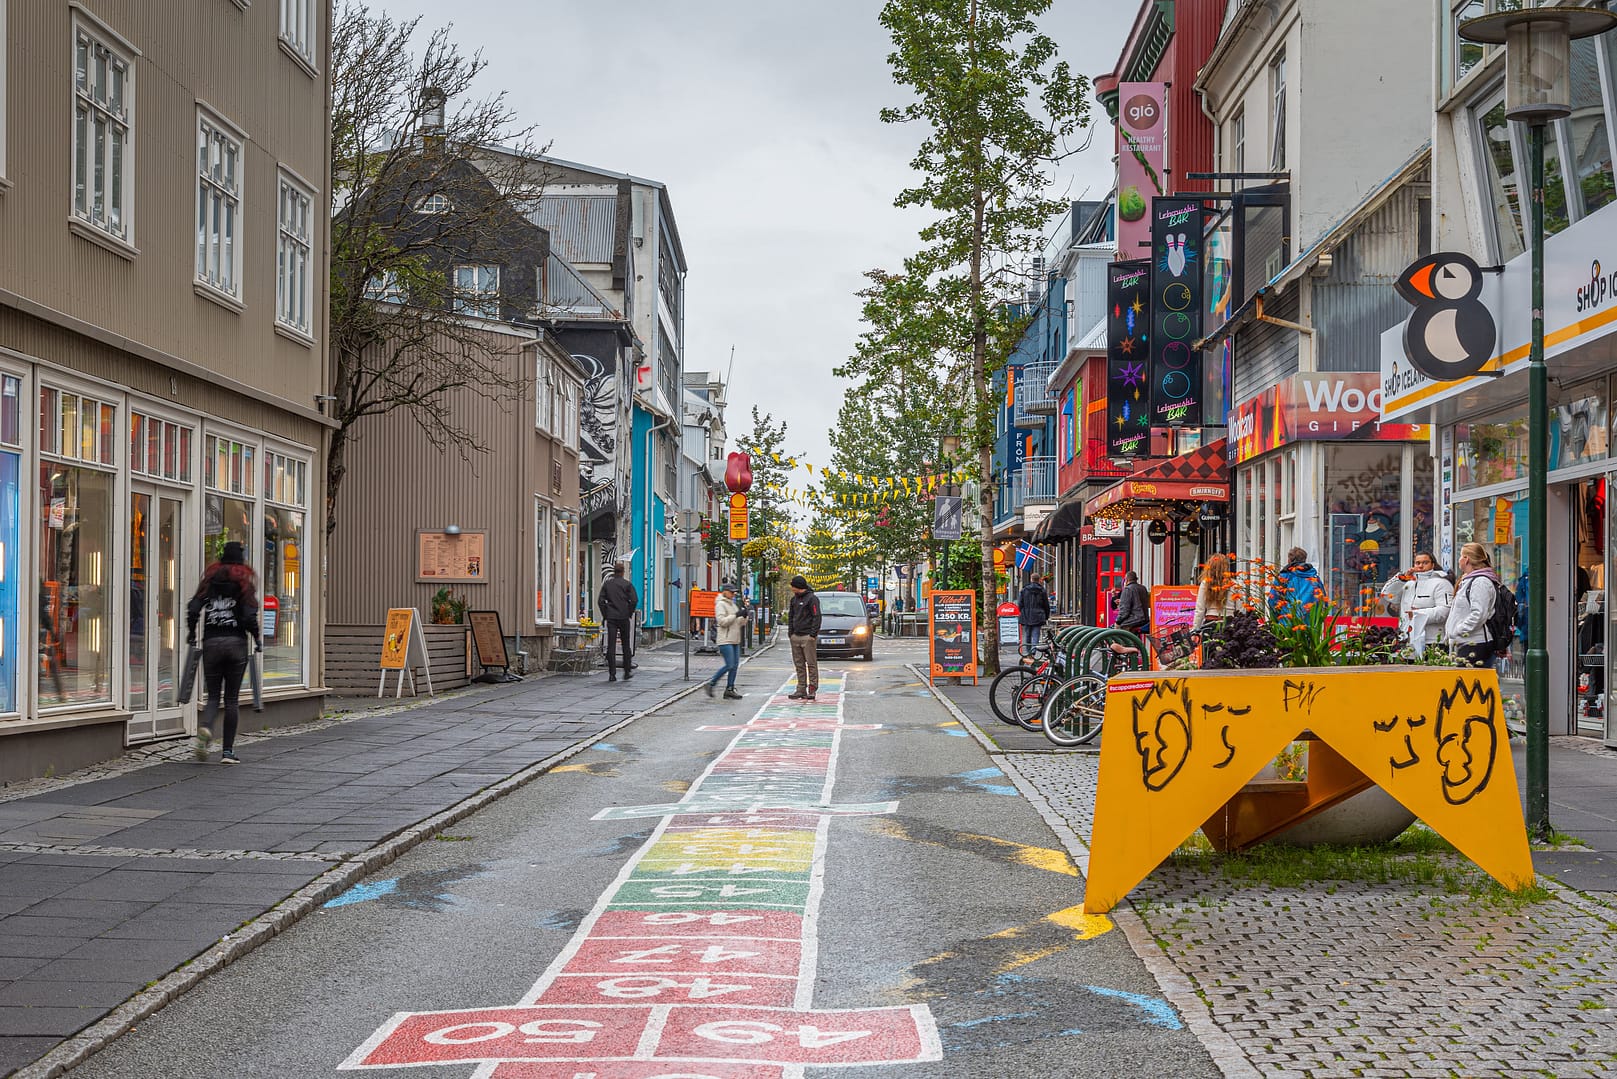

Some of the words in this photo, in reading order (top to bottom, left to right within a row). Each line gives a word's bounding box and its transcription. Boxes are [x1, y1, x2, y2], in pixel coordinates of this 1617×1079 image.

[1129, 103, 1155, 121] gló
[1158, 203, 1198, 220] Lebowski
[1167, 213, 1190, 228] BAR
[1113, 268, 1147, 283] Lebowski
[1120, 276, 1139, 290] BAR
[1576, 265, 1607, 313] SHOP
[1384, 366, 1401, 398] SHOP
[1156, 397, 1198, 414] Lebowski
[1165, 406, 1188, 421] BAR
[1015, 432, 1023, 463] FRÓN
[1112, 432, 1147, 447] Lebowski
[1120, 440, 1139, 453] BAR
[1192, 487, 1224, 497] SMIRNOFF
[650, 884, 773, 898] 45
[643, 911, 764, 926] 46
[614, 944, 761, 965] 47
[597, 976, 753, 999] 48
[423, 1020, 605, 1047] 50
[693, 1020, 873, 1050] 49
